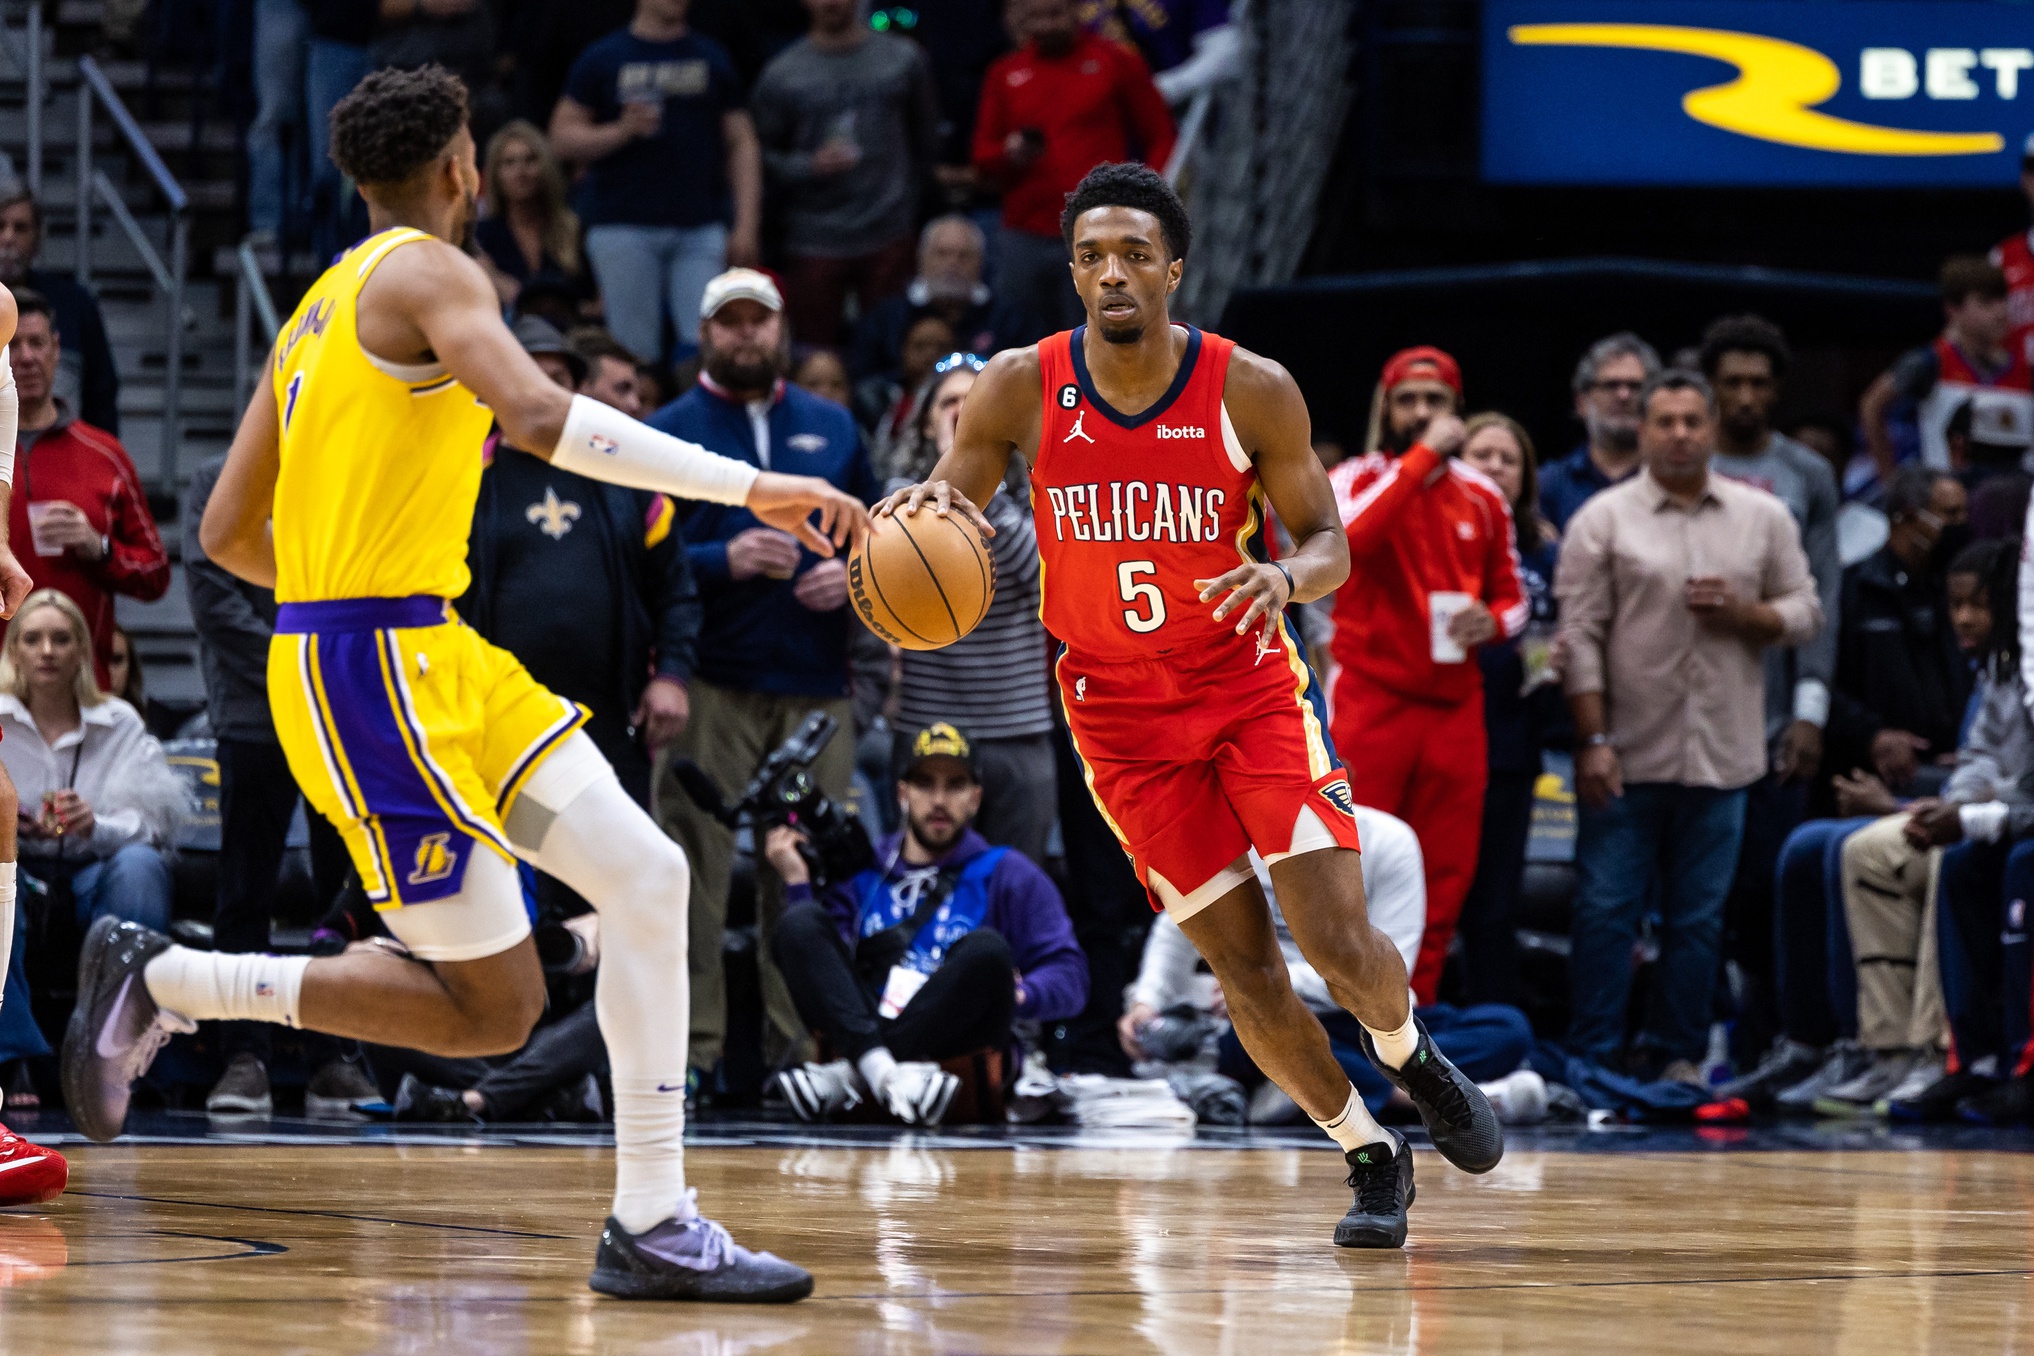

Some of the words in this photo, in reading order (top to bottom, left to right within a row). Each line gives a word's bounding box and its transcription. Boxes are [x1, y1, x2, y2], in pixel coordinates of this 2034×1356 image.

[1859, 47, 2034, 101] BET
[1062, 386, 1077, 408] 6
[1156, 424, 1206, 440] ibotta
[1045, 480, 1226, 543] PELICANS
[850, 555, 902, 644] Wilson
[1116, 560, 1168, 635] 5
